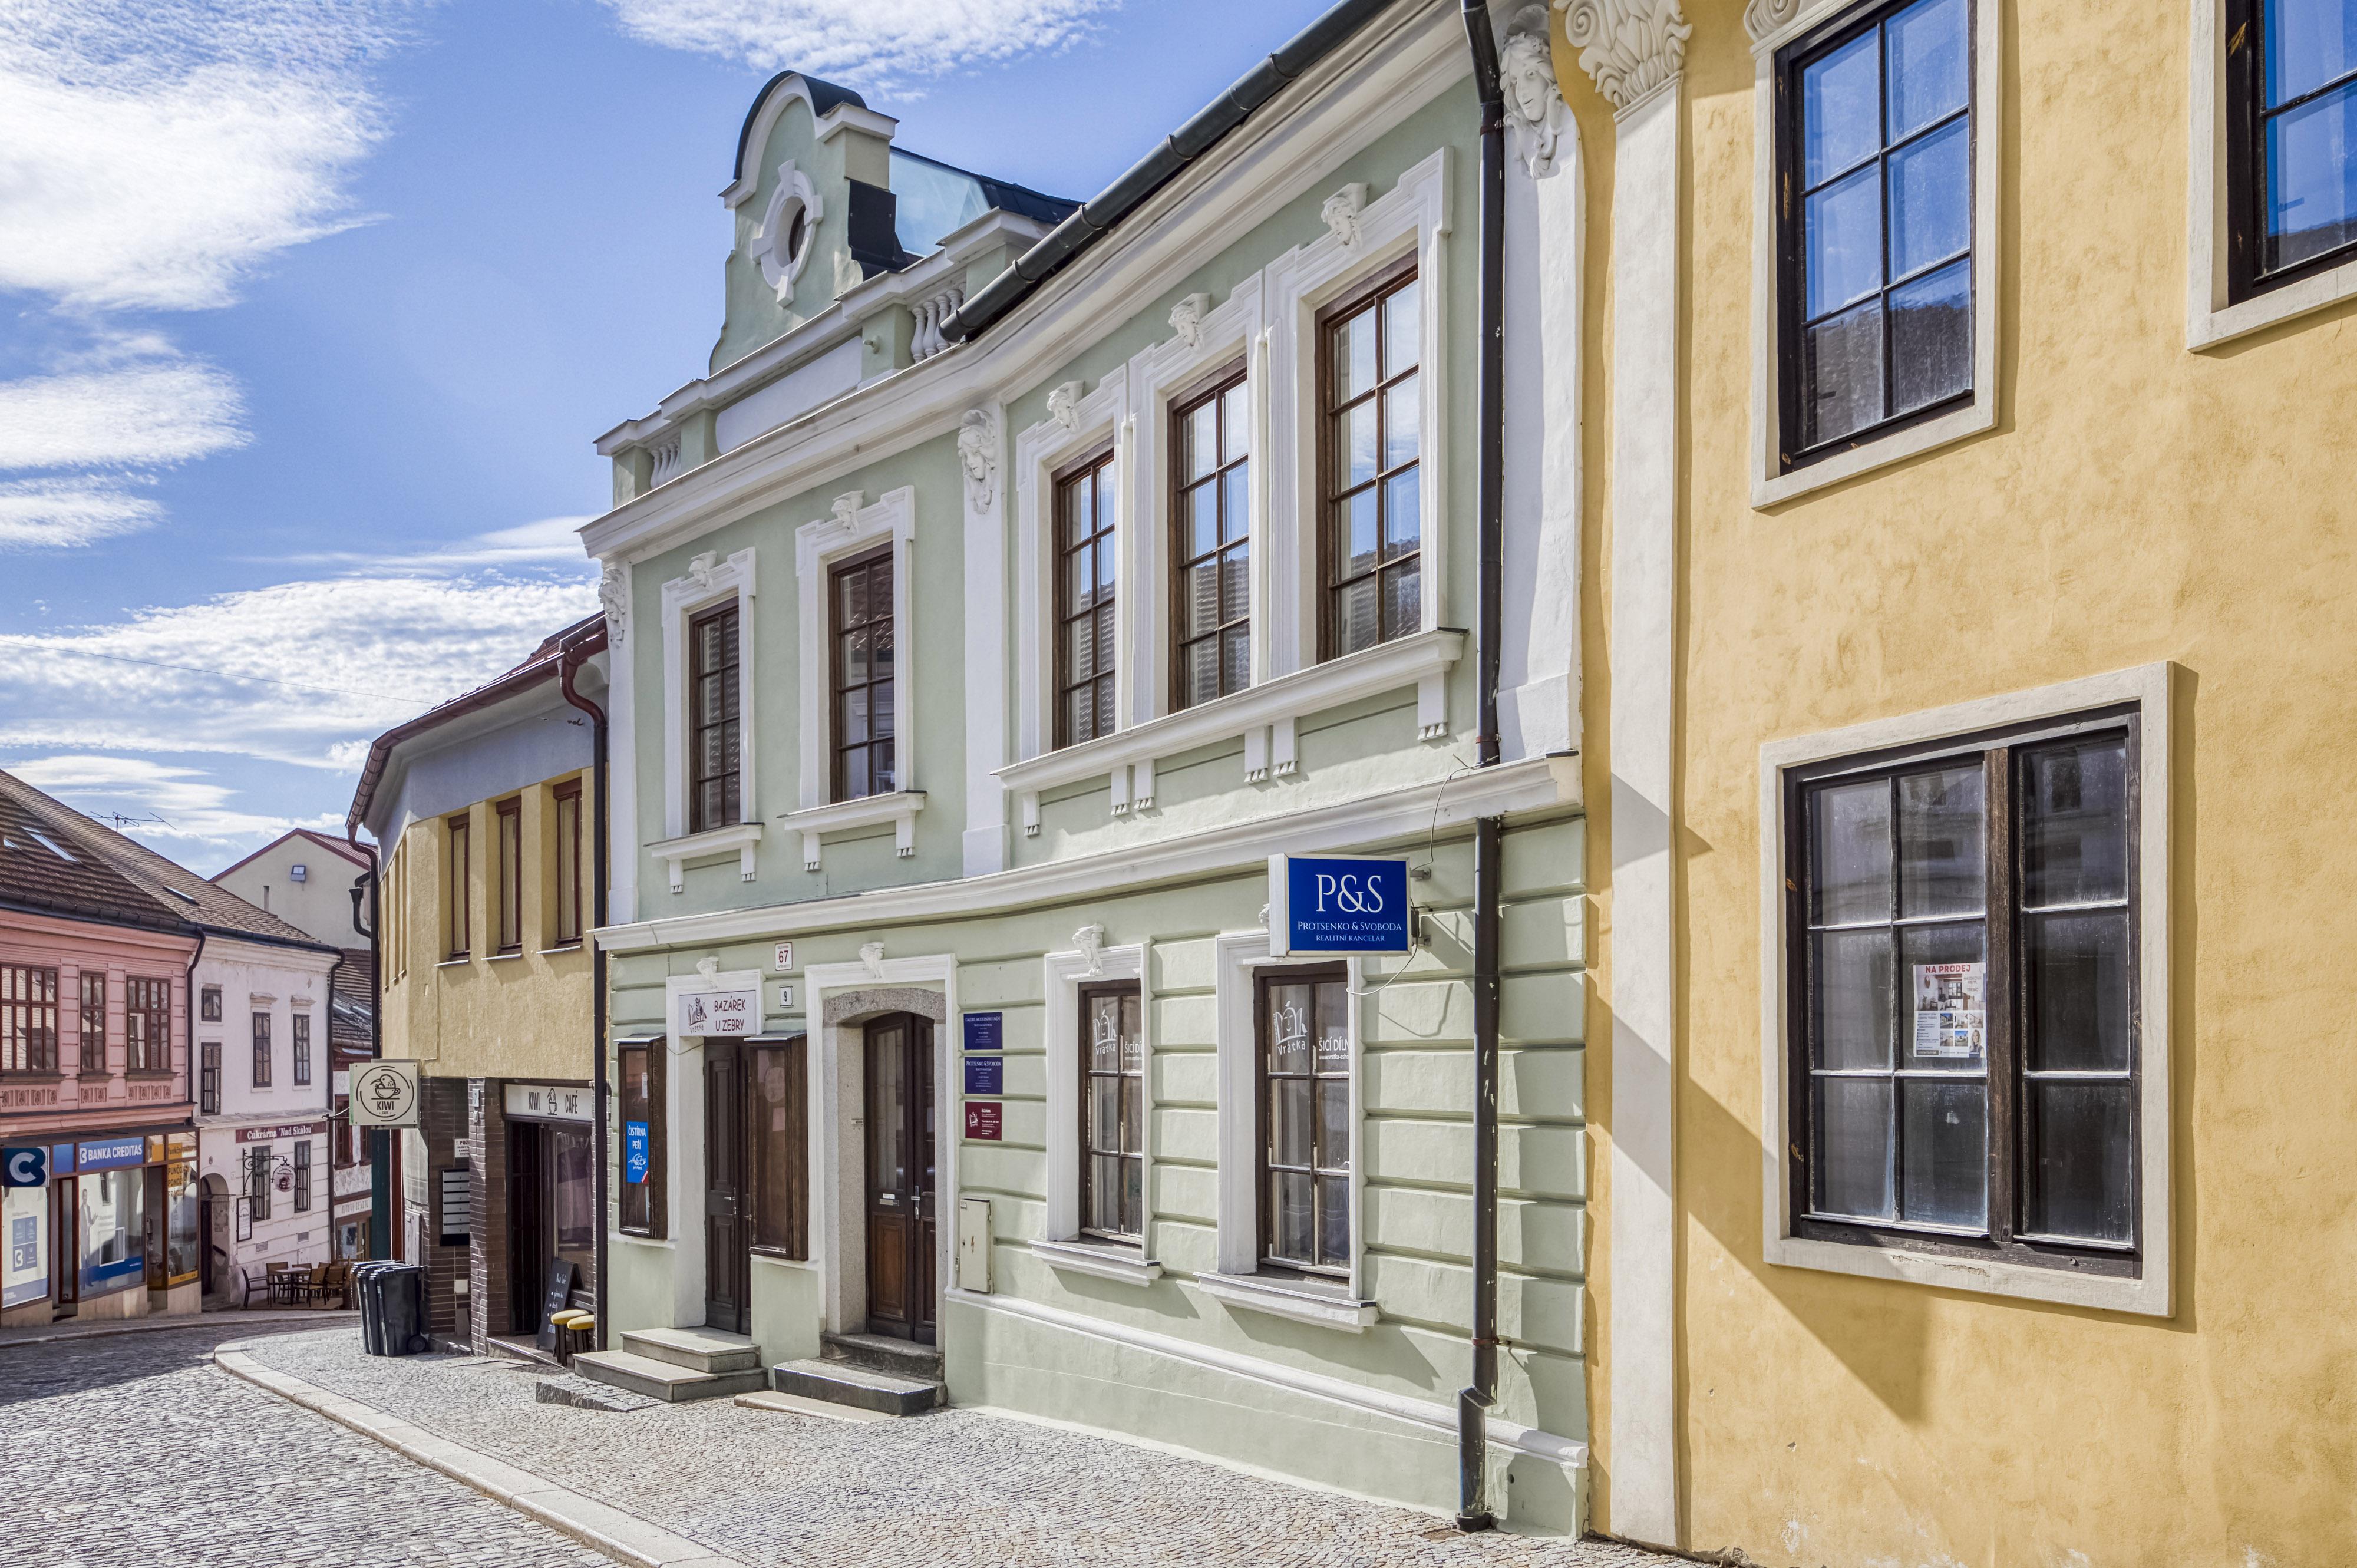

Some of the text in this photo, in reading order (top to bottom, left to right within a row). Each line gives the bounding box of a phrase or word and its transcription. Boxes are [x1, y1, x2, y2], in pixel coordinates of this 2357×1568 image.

[1315, 874, 1384, 913] P&S
[1352, 922, 1358, 930] &
[779, 950, 788, 963] 67
[1939, 965, 1971, 973] PRODEJ
[784, 991, 787, 1002] 9
[714, 996, 746, 1012] BAZÁREK
[715, 1019, 744, 1031] U ZEBRY
[1125, 1041, 1135, 1053] ŠICÍ
[1318, 1036, 1332, 1051] ŠICÍ
[377, 1101, 394, 1110] KIWI
[529, 1090, 578, 1114] KIWI CAFÉ
[247, 1129, 277, 1140] Cukrárna
[628, 1125, 646, 1137] ČISTÍRNA
[632, 1139, 642, 1150] PEŘÍ
[88, 1144, 143, 1161] BANKA CREDITAS
